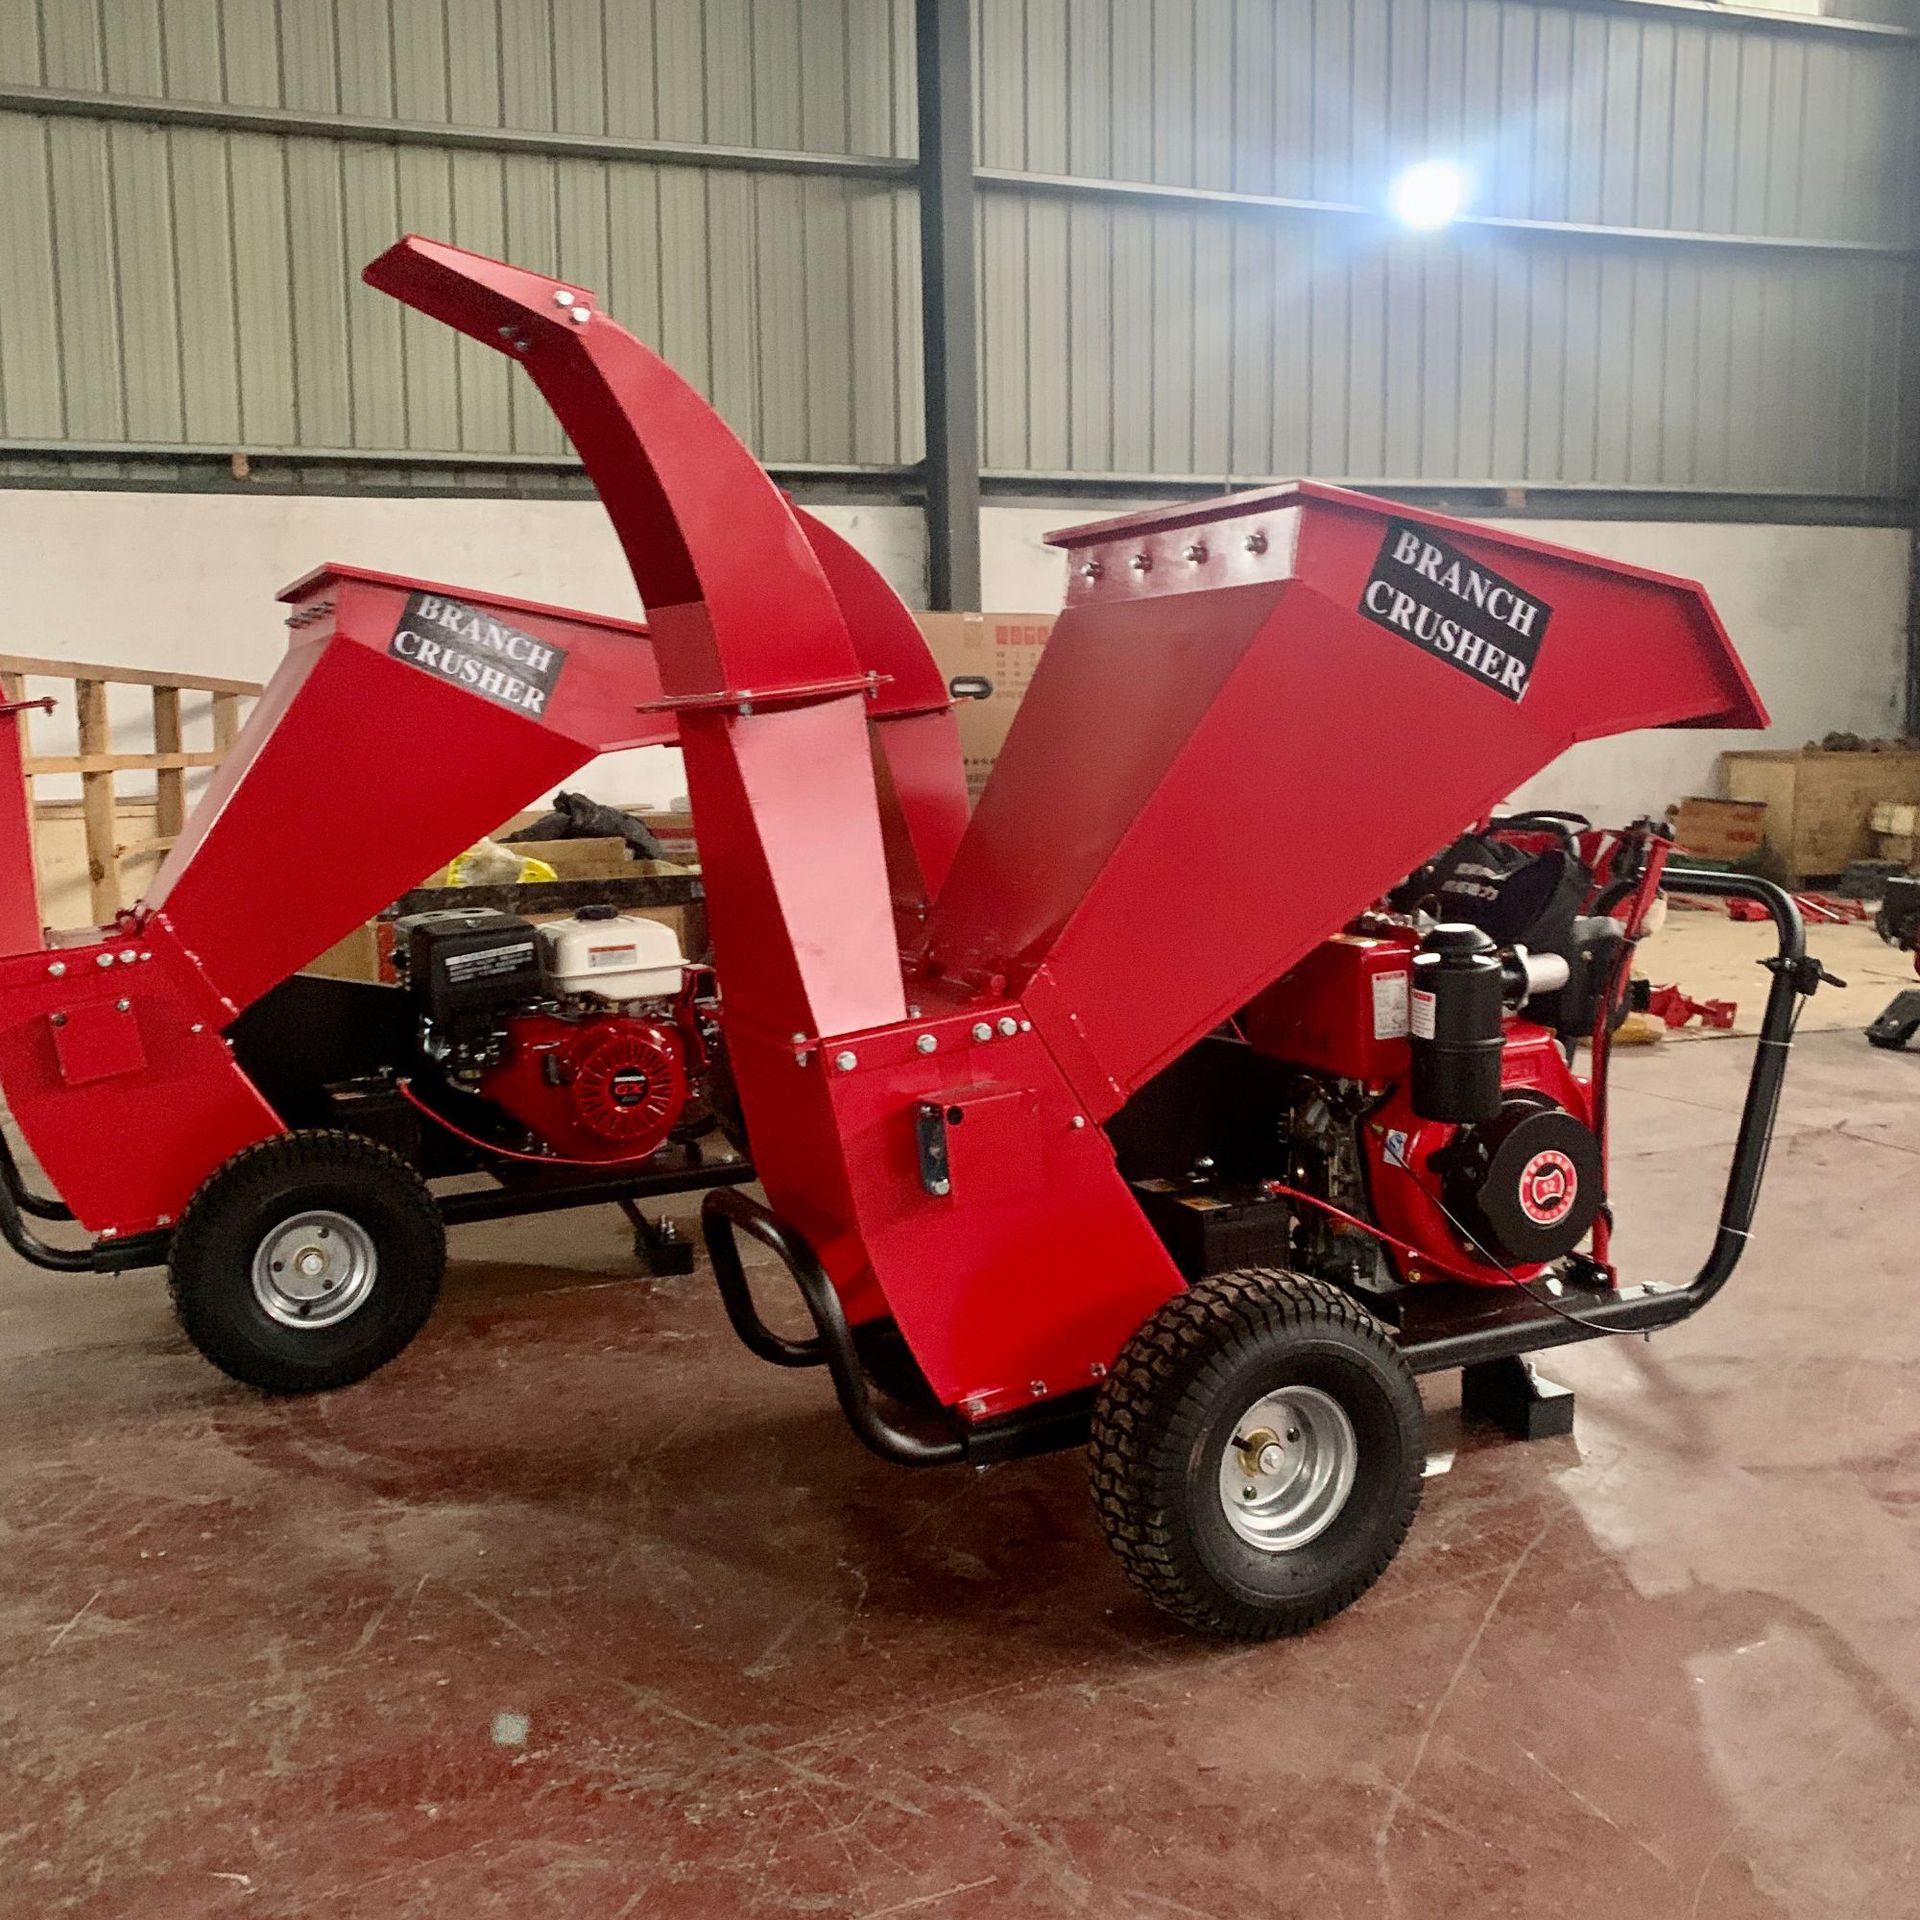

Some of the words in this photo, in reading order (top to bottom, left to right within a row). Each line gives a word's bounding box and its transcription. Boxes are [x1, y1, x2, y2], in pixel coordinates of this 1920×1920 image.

[1391, 529, 1539, 637] BRANCH
[394, 630, 545, 714] CRUSHER
[416, 595, 555, 673] BRANCH
[1365, 580, 1527, 693] CRUSHER
